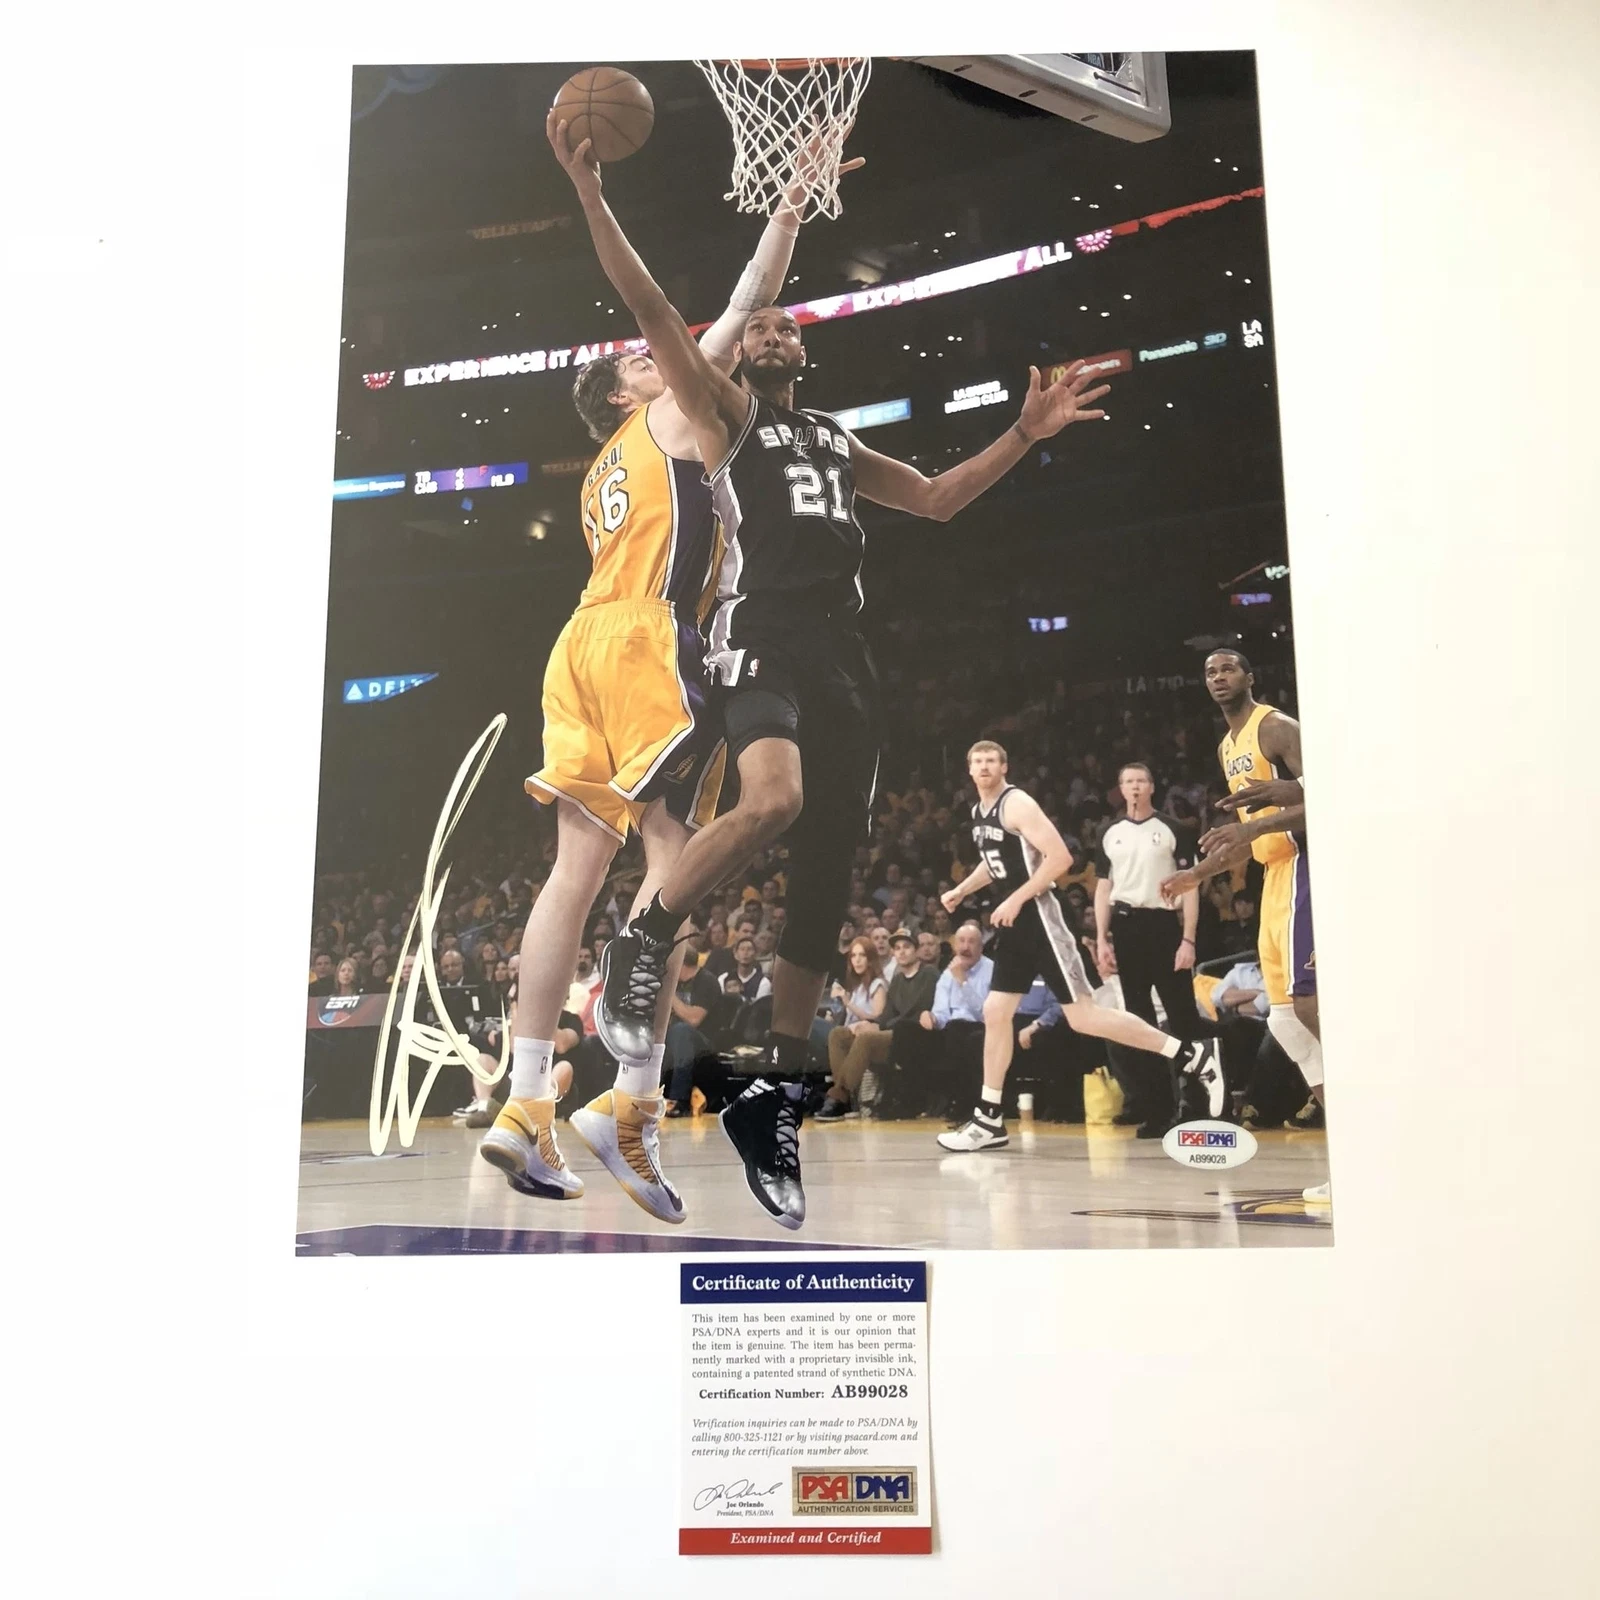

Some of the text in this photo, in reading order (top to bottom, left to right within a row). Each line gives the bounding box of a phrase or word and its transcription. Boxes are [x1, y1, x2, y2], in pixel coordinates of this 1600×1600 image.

[1024, 242, 1072, 272] ALL
[1243, 320, 1262, 335] LA
[783, 463, 850, 523] 21
[325, 995, 360, 1010] ESPN
[1181, 1132, 1234, 1147] PSA DNA
[1189, 1154, 1227, 1164] AB99028
[692, 1273, 915, 1293] Certificate of Authenticity
[692, 1313, 714, 1323] This
[718, 1313, 738, 1323] item
[742, 1313, 760, 1323] has
[762, 1312, 786, 1323] been
[790, 1312, 834, 1322] examined
[838, 1312, 850, 1324] by
[892, 1314, 916, 1322] more
[692, 1327, 740, 1337] PSA/DNA
[746, 1326, 780, 1338] experts
[786, 1326, 802, 1336] and
[808, 1326, 816, 1336] it
[820, 1326, 830, 1336] is
[856, 1326, 892, 1338] opinion
[898, 1326, 916, 1336] that
[692, 1340, 916, 1352] the item is genuine. The item has been perma-
[692, 1353, 916, 1366] nently marked with a proprietary invisible ink,
[692, 1368, 742, 1380] containing
[752, 1368, 794, 1380] patented
[796, 1368, 826, 1378] strand
[830, 1368, 840, 1378] of
[842, 1368, 886, 1380] synthetic
[888, 1368, 916, 1377] DNA.
[699, 1384, 908, 1399] Certification Number: AB99028
[692, 1418, 918, 1430] Verification inquiries can be made to PSA/DNA by
[690, 1431, 918, 1444] calling 800-325-1121 or by visiting psacard.com and
[690, 1446, 868, 1459] entering the certification number above.
[801, 1475, 849, 1502] PSA
[855, 1475, 909, 1502] DNA
[726, 1501, 737, 1509] Joe
[797, 1504, 914, 1513] AUTHENTICATION SERVICES
[730, 1531, 882, 1545] Examined and Certified
